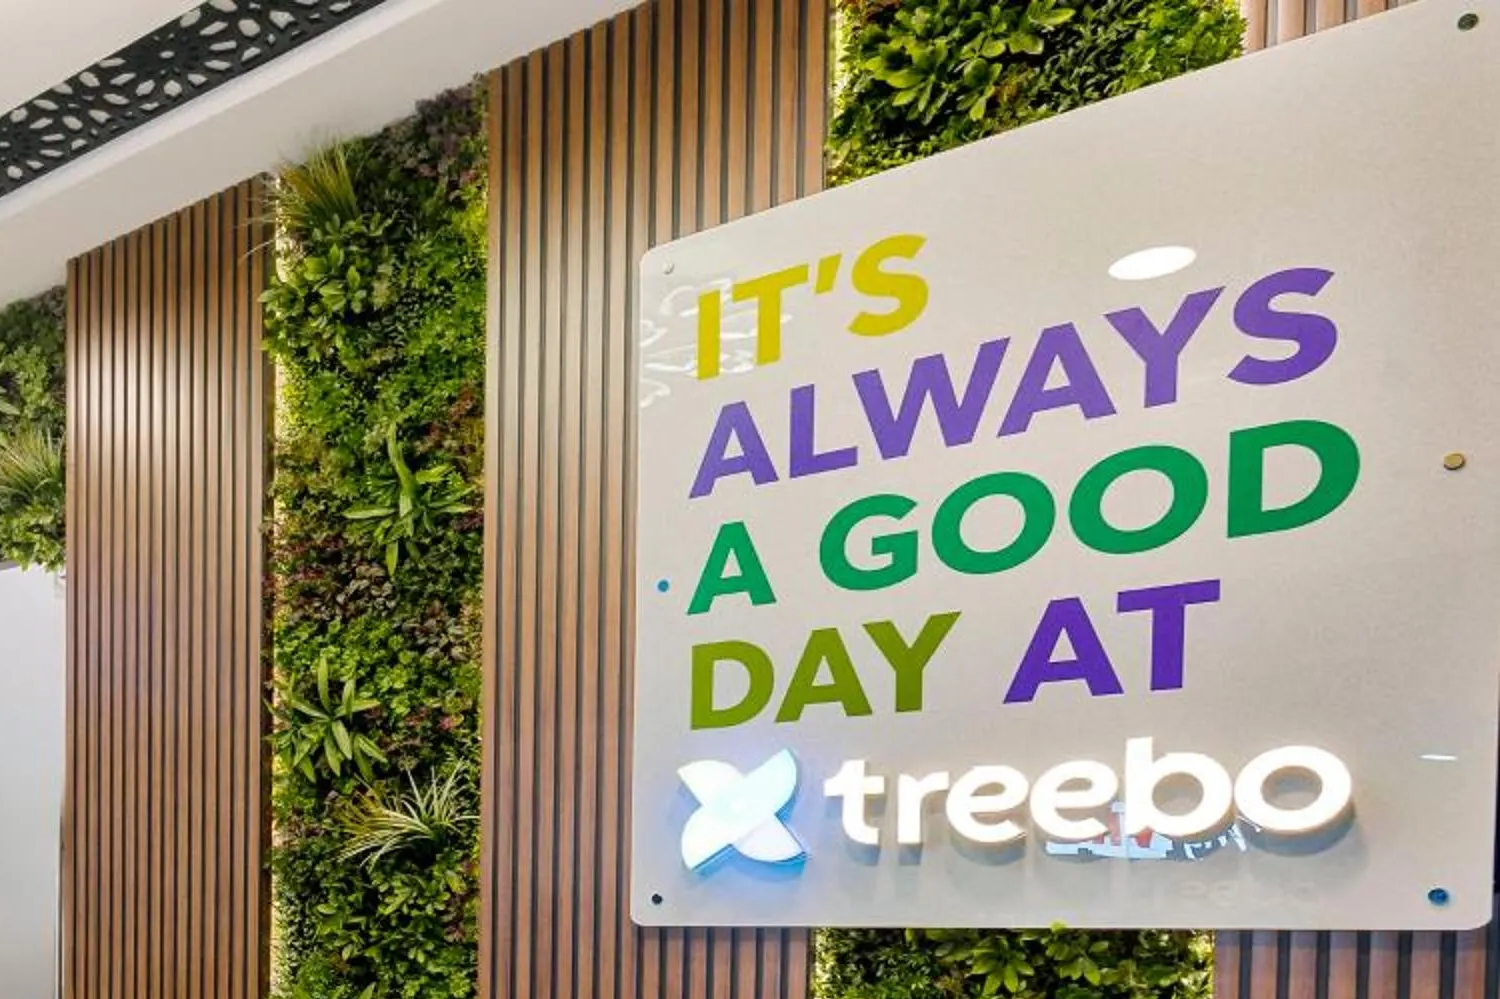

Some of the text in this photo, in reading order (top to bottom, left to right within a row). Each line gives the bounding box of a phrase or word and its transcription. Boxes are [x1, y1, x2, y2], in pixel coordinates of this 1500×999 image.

[694, 233, 930, 380] IT'S
[688, 267, 1338, 499] ALWAYS
[686, 419, 1361, 616] A GOOD
[690, 579, 1221, 731] DAY AT
[823, 735, 1353, 846] treebo
